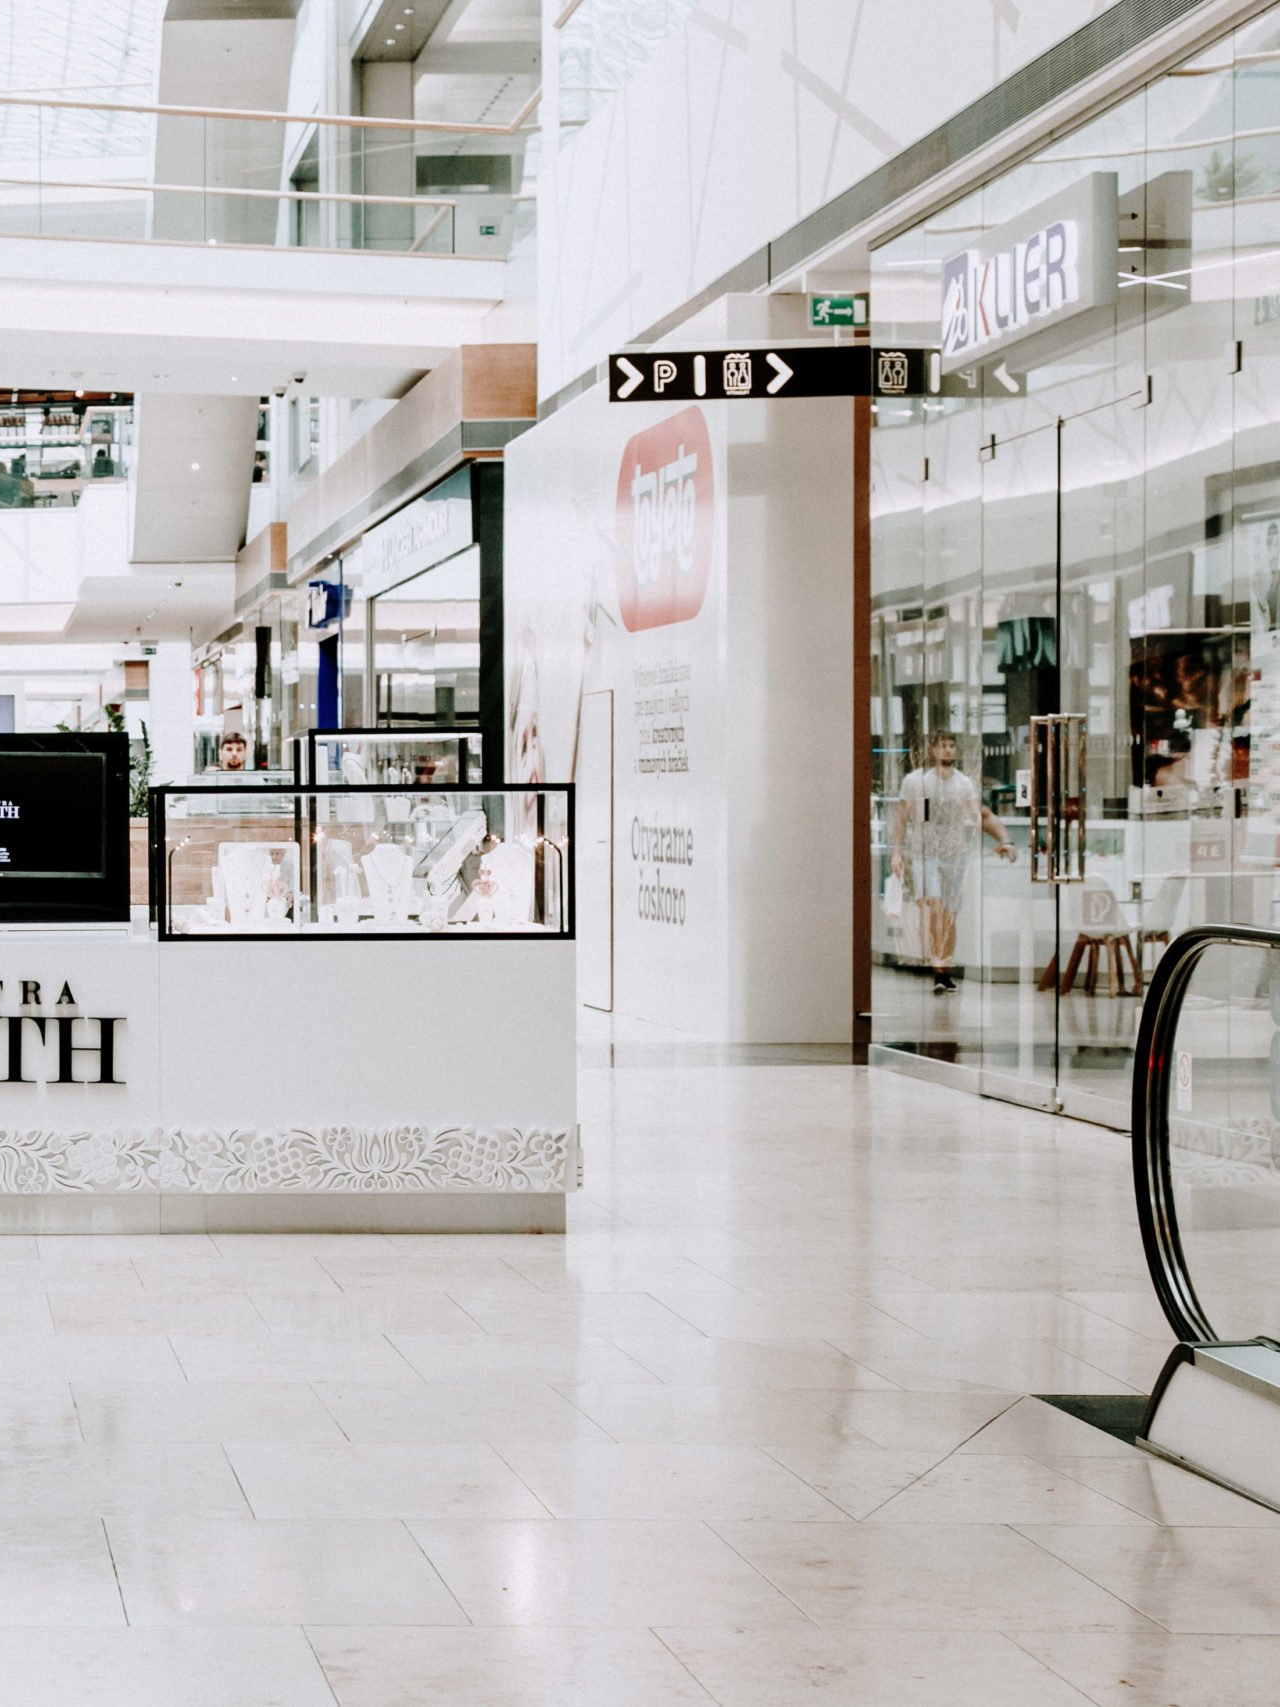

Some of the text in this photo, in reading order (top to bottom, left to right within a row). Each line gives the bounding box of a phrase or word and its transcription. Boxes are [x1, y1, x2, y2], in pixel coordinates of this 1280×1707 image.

[973, 220, 1078, 346] KLIER
[654, 360, 677, 393] P
[631, 810, 694, 867] Otvárame
[638, 866, 686, 926] čoskoro
